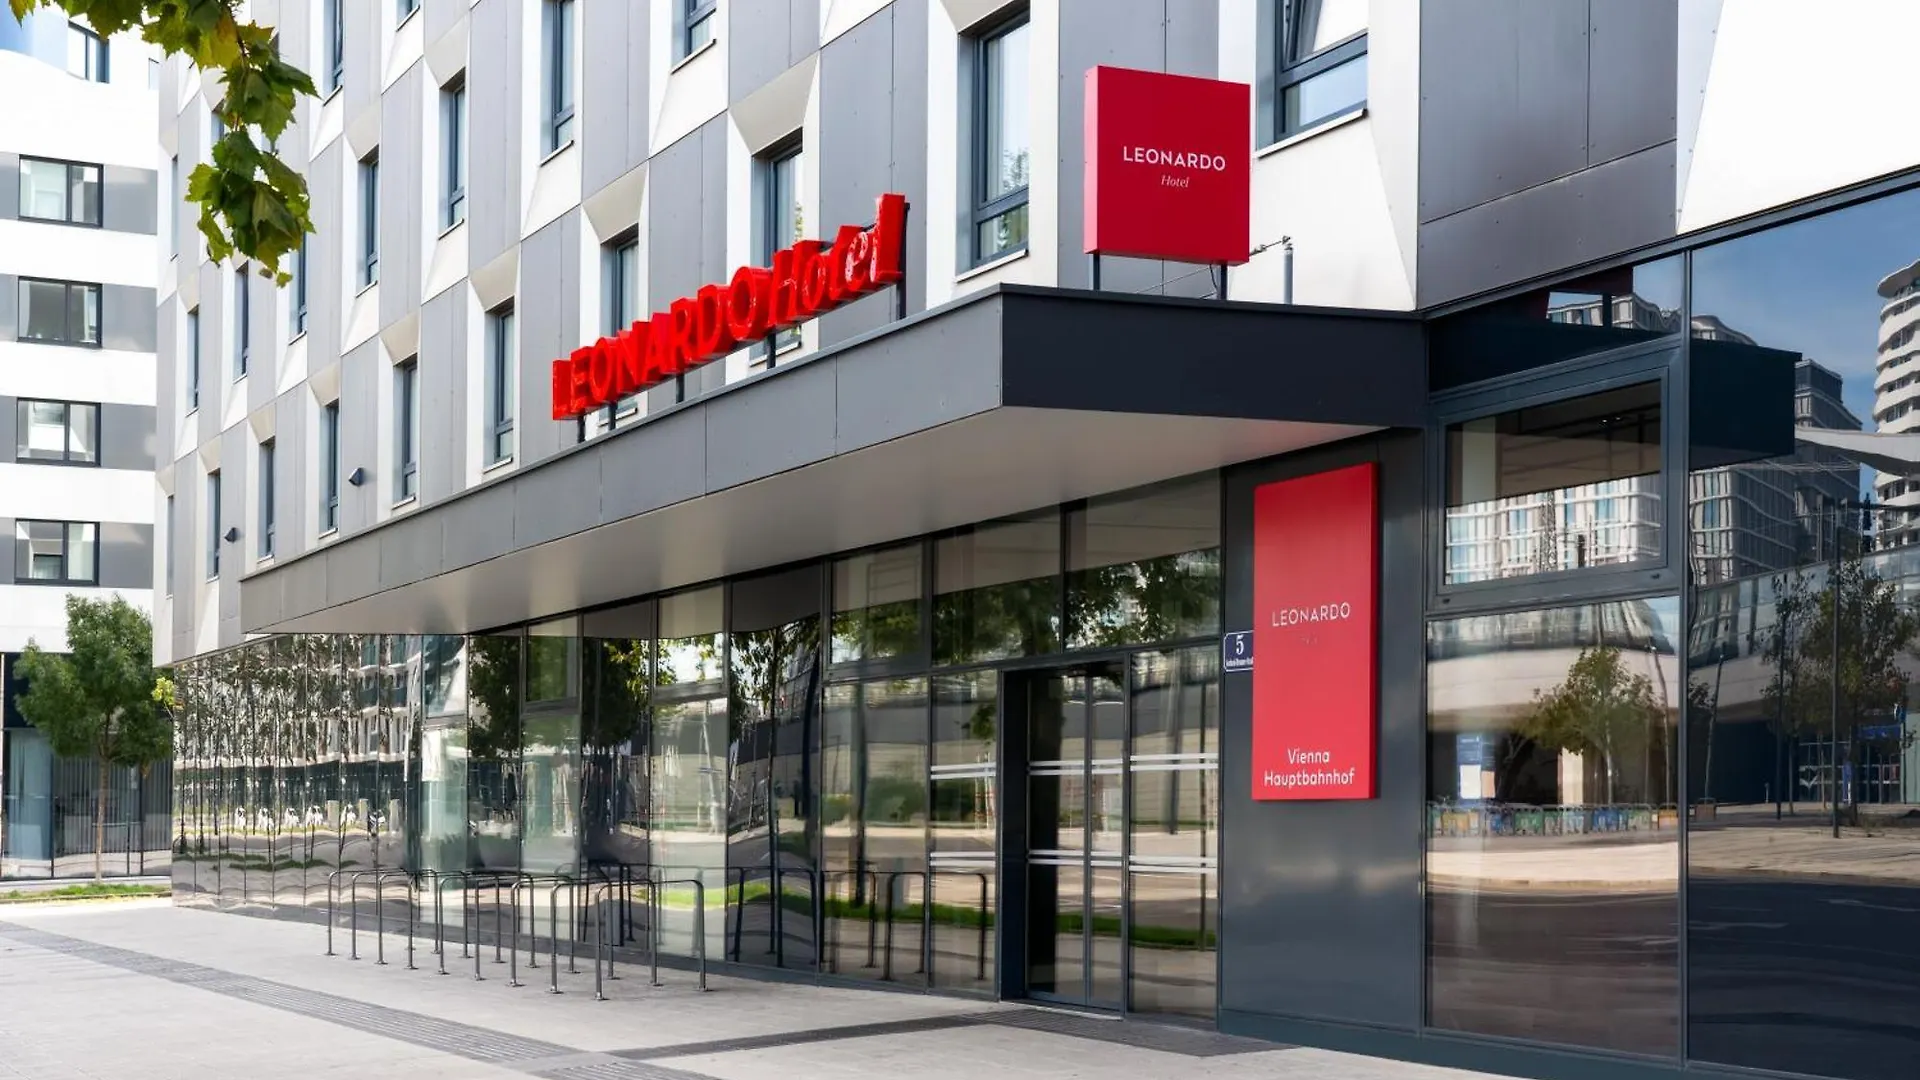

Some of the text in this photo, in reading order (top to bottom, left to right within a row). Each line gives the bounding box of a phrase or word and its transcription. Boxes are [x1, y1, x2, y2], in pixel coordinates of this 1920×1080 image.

[1122, 145, 1227, 172] LEONARDO
[1160, 175, 1190, 189] Hotel
[552, 192, 906, 421] LEONARDO Hotel
[1272, 602, 1350, 627] LEONARDO
[1236, 634, 1244, 655] 5
[1287, 747, 1330, 764] Vienna
[1264, 767, 1355, 790] Hauptbahnhof
